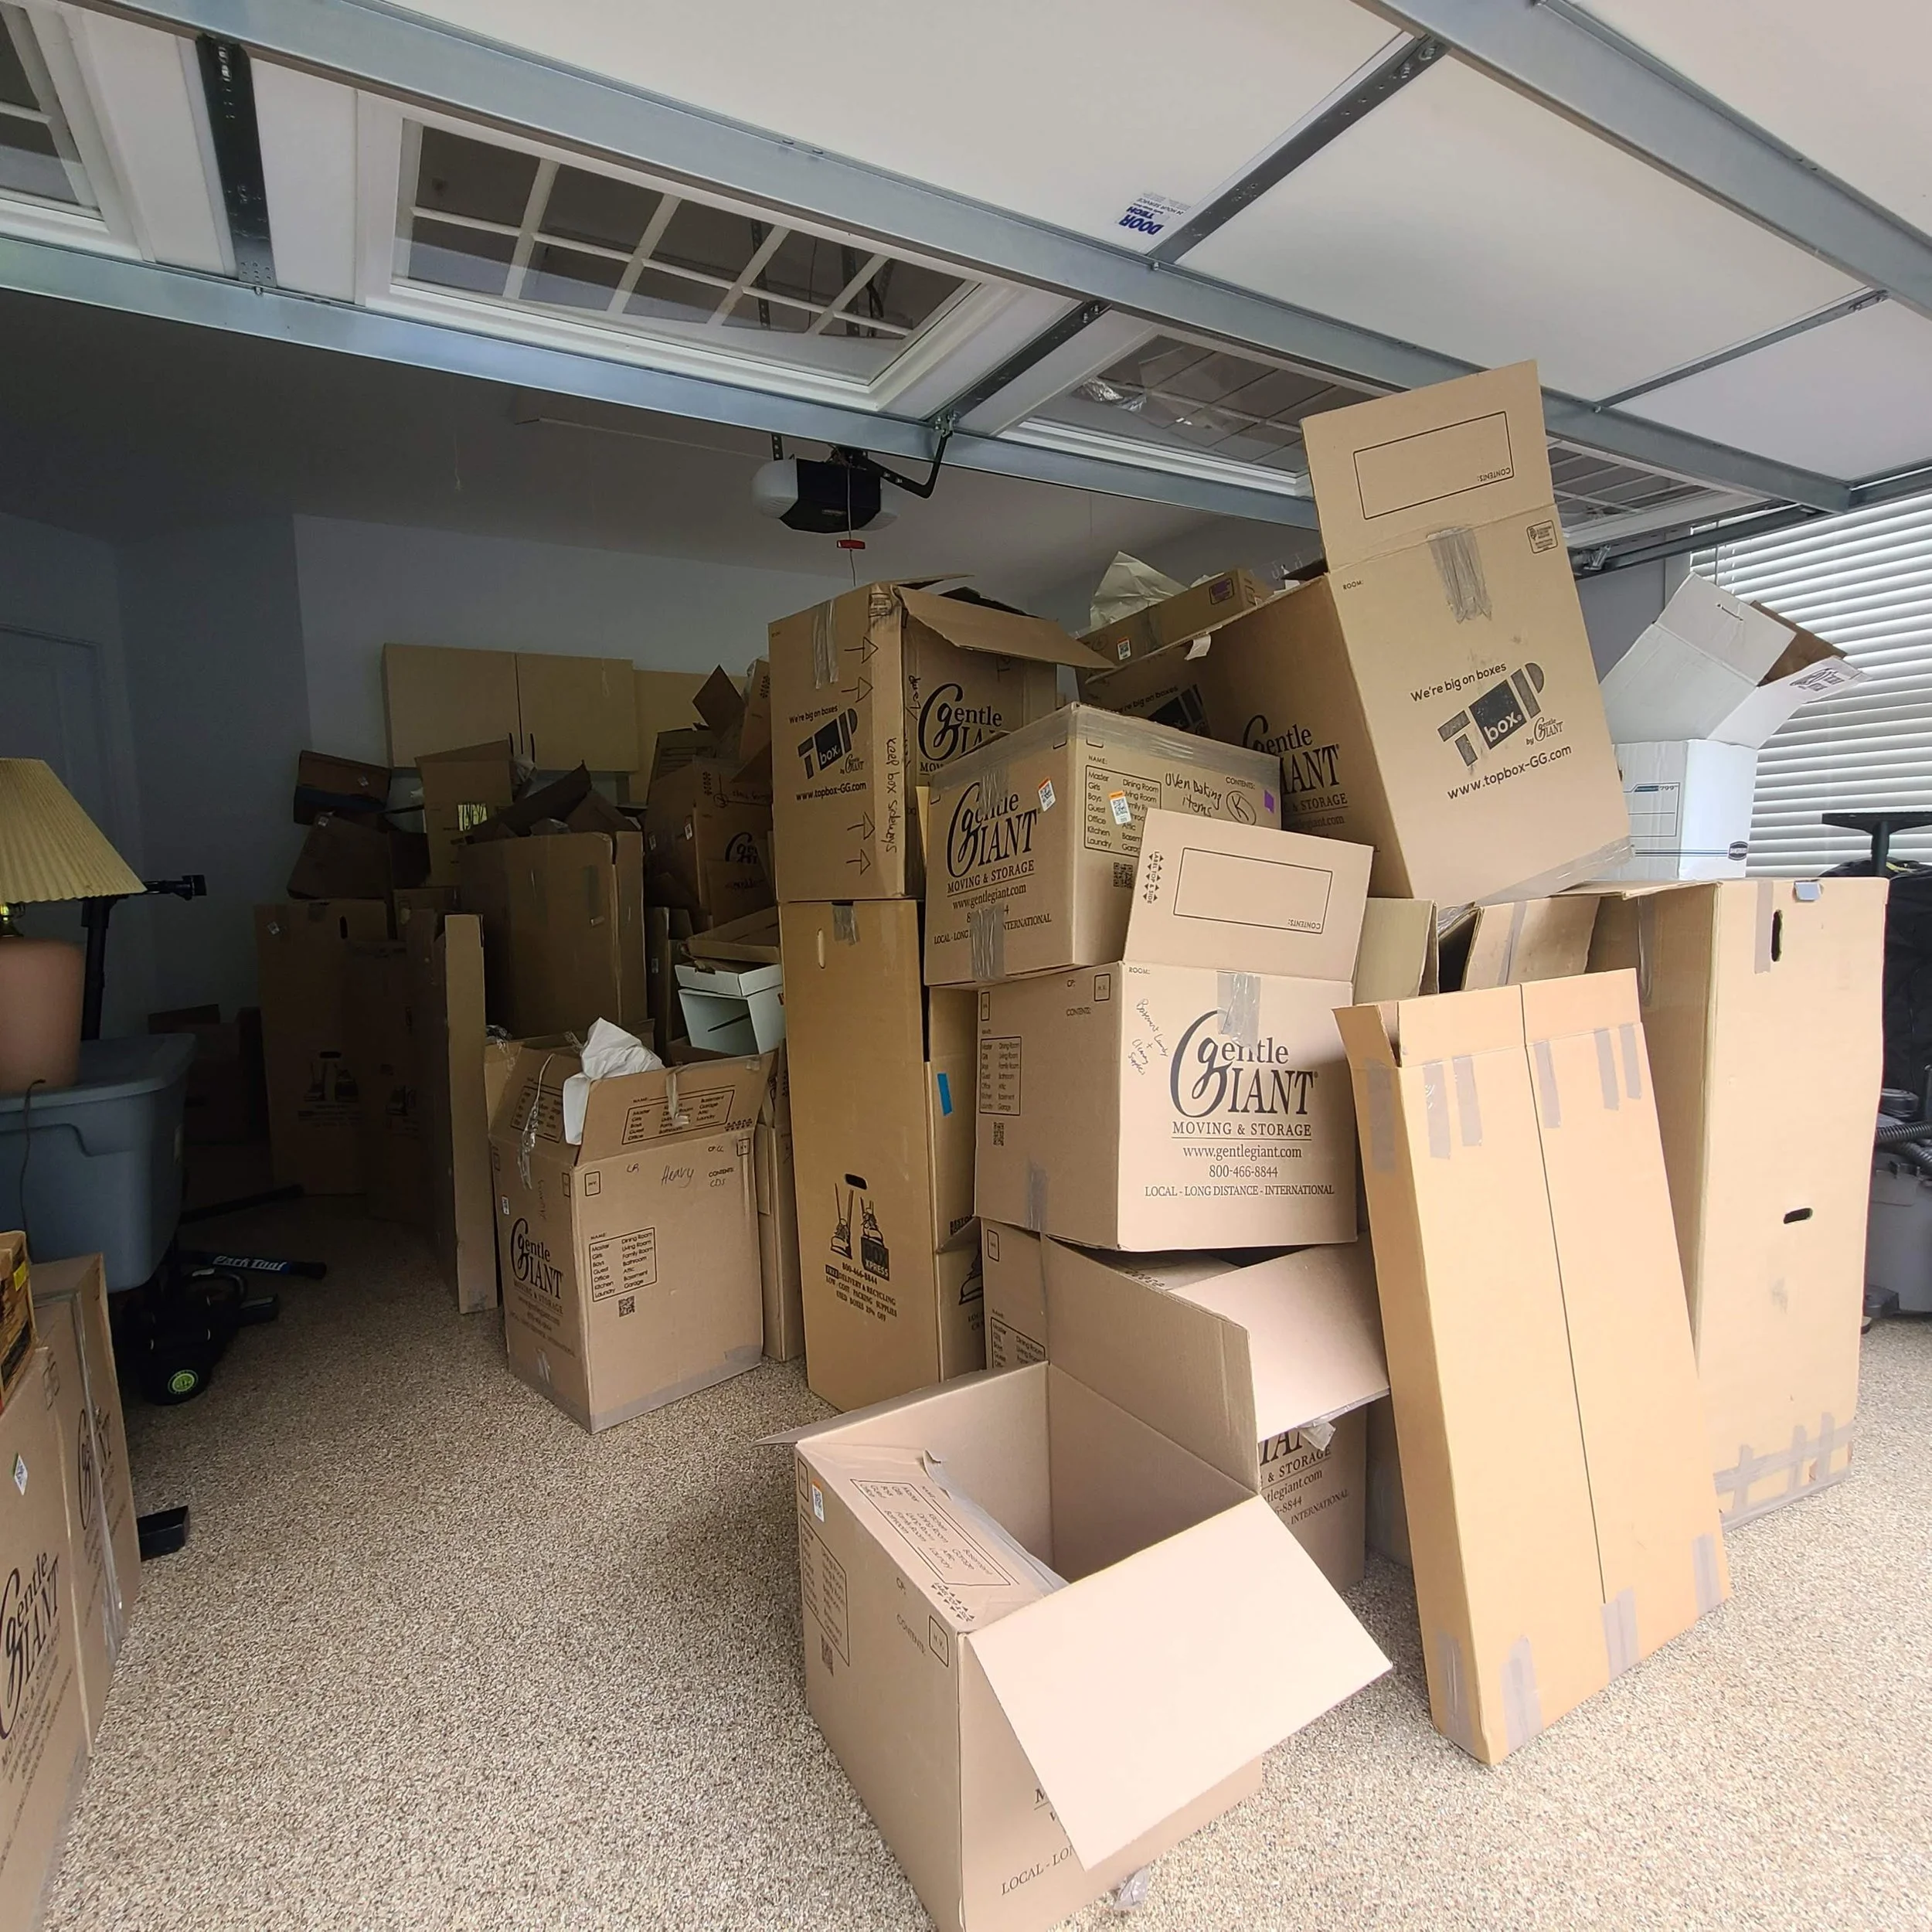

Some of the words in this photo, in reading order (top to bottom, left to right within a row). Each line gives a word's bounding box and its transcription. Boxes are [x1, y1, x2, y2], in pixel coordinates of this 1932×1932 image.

[1126, 206, 1155, 219] TECH
[1118, 214, 1164, 235] DOOR
[1477, 468, 1511, 482] CONTENTS:
[1410, 685, 1444, 702] We're
[1444, 679, 1462, 691] big
[1462, 673, 1475, 685] on
[1476, 662, 1507, 680] boxes
[789, 713, 804, 724] We're
[805, 711, 814, 722] big
[814, 709, 821, 718] on
[821, 705, 838, 716] boxes
[1526, 736, 1535, 746] by
[1088, 754, 1107, 765] NAME:
[1447, 746, 1572, 799] www.topbox-GG.com
[796, 781, 867, 801] www.topbox-GG.com
[1088, 771, 1109, 782] Master
[1123, 778, 1141, 791] Dining
[1142, 784, 1159, 793] Room
[1226, 776, 1256, 791] CONTENTS:
[1088, 792, 1102, 803] Boys
[1140, 794, 1157, 803] Room
[1182, 794, 1212, 818] items
[1301, 793, 1348, 811] STORAGE
[1088, 804, 1105, 814] Guest
[1231, 795, 1249, 821] K
[1088, 815, 1107, 825] Office
[1087, 825, 1111, 837] Kitchen
[1087, 837, 1112, 849] Laundry
[947, 872, 981, 893] MOVING
[983, 874, 989, 883] &
[991, 859, 1035, 881] STORAGE
[952, 883, 1026, 910] www.gentlegiant.com
[1287, 919, 1321, 930] CONTENTS:
[934, 930, 951, 946] LOCAL
[953, 929, 969, 941] LONG
[1172, 1121, 1232, 1134] MOVING
[1237, 1124, 1246, 1134] &
[1250, 1123, 1312, 1137] STORAGE
[1183, 1145, 1302, 1161] www.gentlegiant.com
[662, 1165, 695, 1188] Heavy
[1209, 1165, 1278, 1178] 800-466-8844
[1145, 1186, 1178, 1196] LOCAL
[1184, 1186, 1212, 1196] LONG
[1213, 1185, 1258, 1196] DISTANCE
[1264, 1185, 1335, 1196] INTERNATIONAL
[623, 1256, 647, 1267] Bathroom
[866, 1259, 888, 1277] XPRESS
[594, 1281, 614, 1290] Kitchen
[624, 1270, 648, 1281] Basement
[595, 1288, 615, 1298] Laundry
[624, 1280, 644, 1288] Garage
[838, 1272, 862, 1289] DELIVERY
[866, 1285, 896, 1306] RECYCLING
[826, 1275, 835, 1285] LOW
[838, 1282, 850, 1293] COST
[853, 1289, 872, 1304] PACKING
[876, 1301, 897, 1318] SUPPLIES
[1267, 1472, 1274, 1483] &
[1279, 1448, 1332, 1478] STORAGE
[1291, 1489, 1349, 1525] INTERNATIONAL
[928, 1547, 952, 1570] Laundry
[952, 1548, 975, 1570] Garage
[962, 1549, 993, 1575] Basement
[896, 1614, 927, 1657] CONTENTS:
[1002, 1862, 1044, 1896] LOCAL
